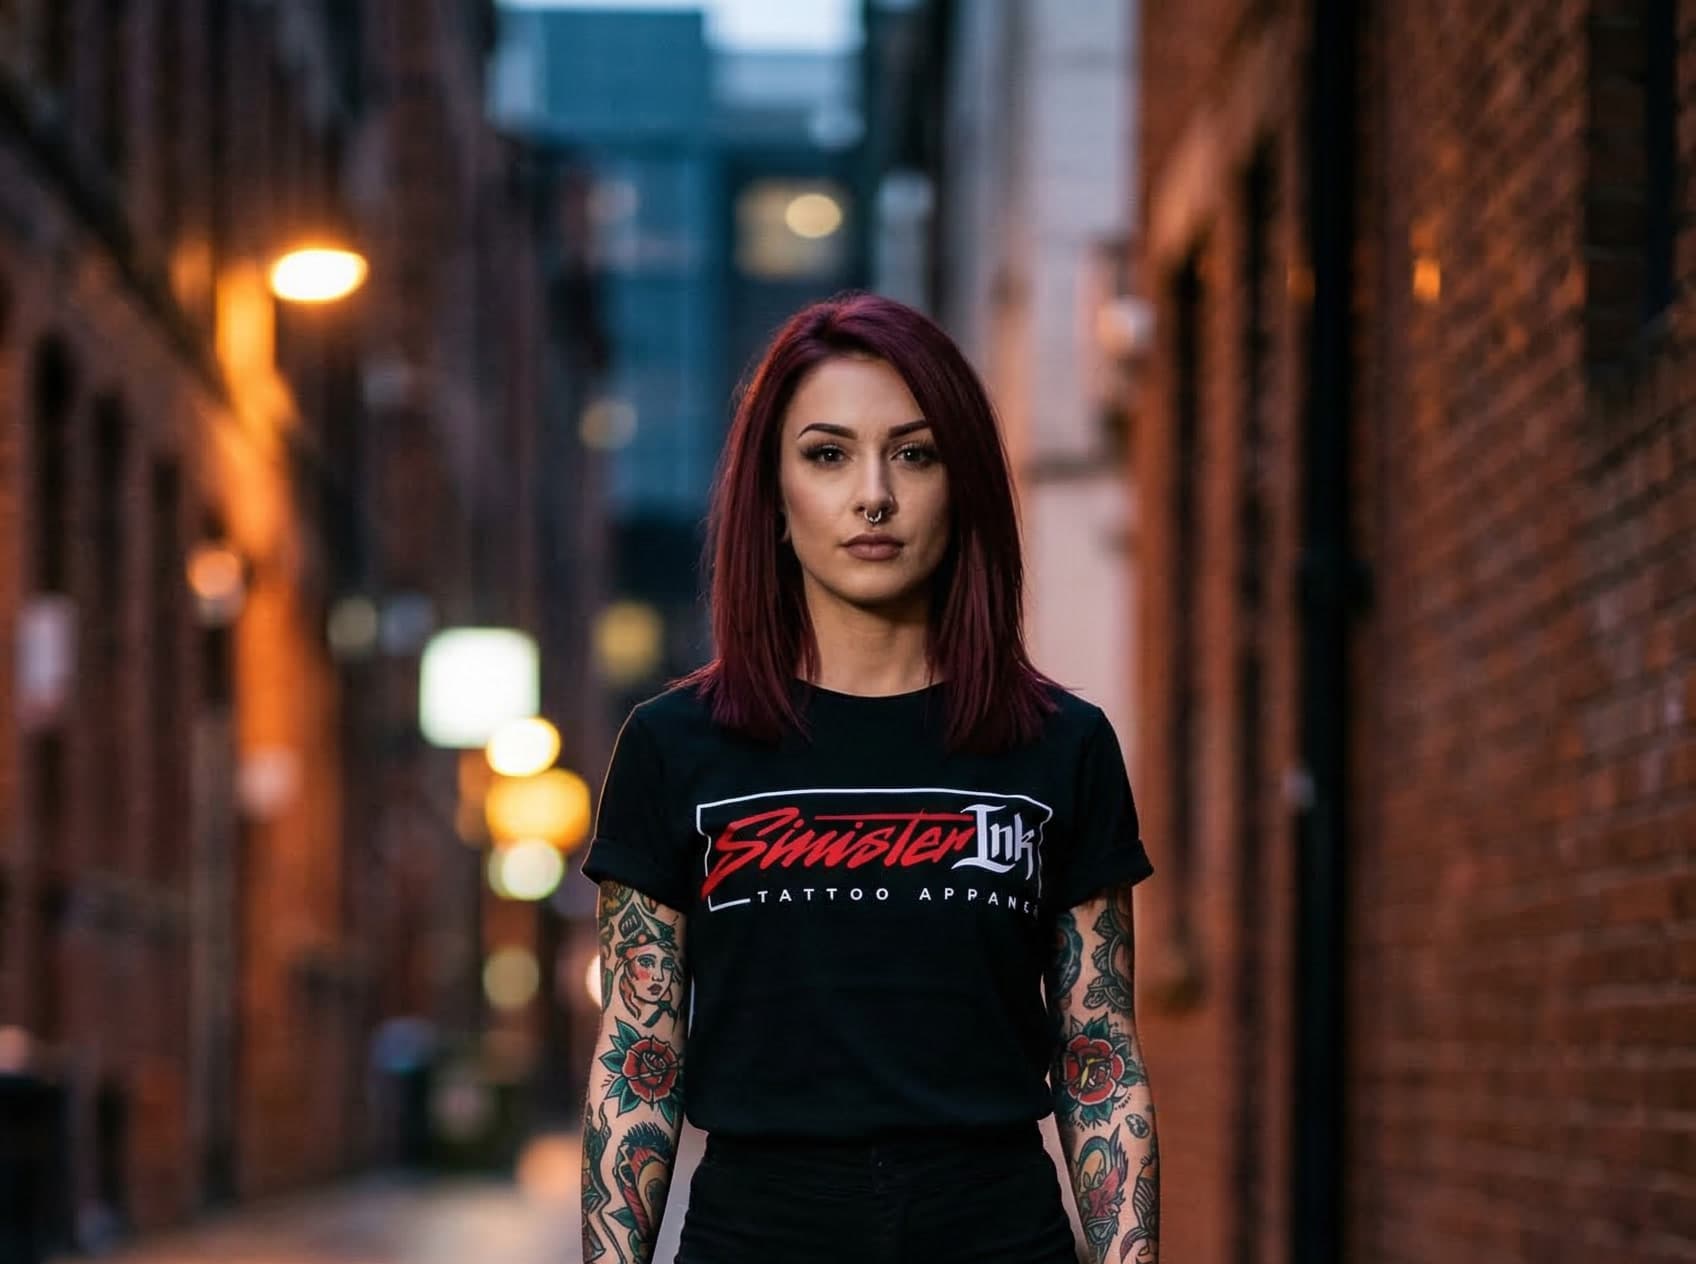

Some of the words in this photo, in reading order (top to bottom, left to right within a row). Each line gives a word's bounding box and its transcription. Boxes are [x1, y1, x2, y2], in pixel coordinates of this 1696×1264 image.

[701, 807, 976, 900] Sinister
[951, 804, 1036, 881] Ink
[757, 887, 890, 903] TATTOO
